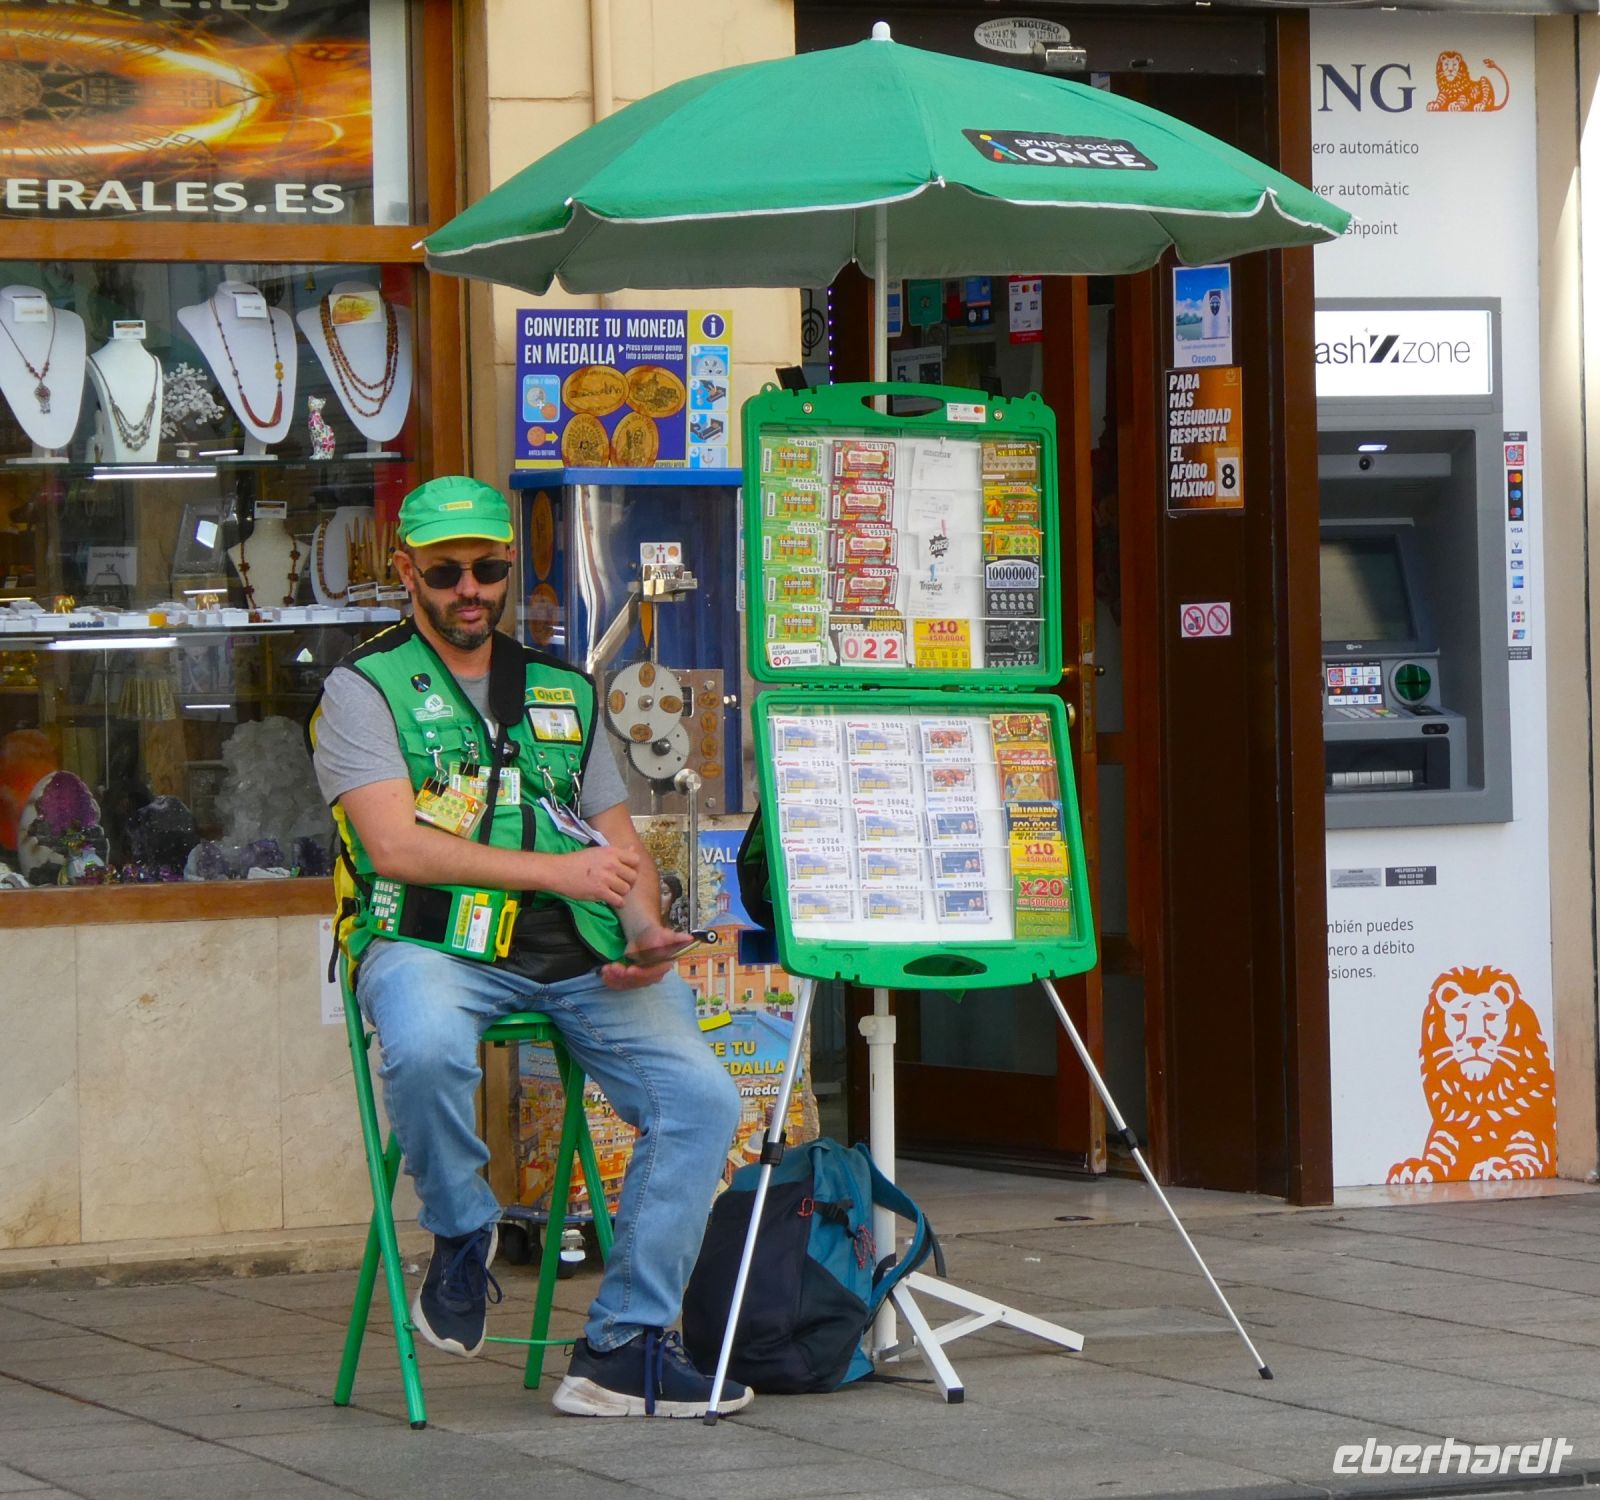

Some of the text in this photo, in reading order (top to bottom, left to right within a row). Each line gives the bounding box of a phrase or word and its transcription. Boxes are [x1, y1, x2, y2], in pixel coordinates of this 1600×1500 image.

[1012, 19, 1060, 34] TRIGUERO
[984, 38, 1017, 49] VALENCIA
[1317, 63, 1416, 113] NG
[1014, 137, 1129, 153] grupo social
[1339, 140, 1419, 154] automático
[1025, 148, 1147, 168] ONCE
[6, 179, 345, 214] ERALES.ES
[1338, 181, 1410, 196] automàtic
[1344, 221, 1398, 237] shpoint
[524, 317, 685, 339] CONVIERTE TU MONEDA
[524, 344, 616, 365] EN MEDALLA
[1191, 354, 1217, 364] Ozono
[1402, 341, 1471, 364] zone
[1169, 374, 1200, 391] PARA
[1169, 388, 1194, 409] MÁS
[1170, 408, 1232, 427] SEGURIDAD
[1170, 446, 1184, 462] EL
[1221, 463, 1236, 489] 8
[1170, 479, 1216, 498] MÁXIMO
[537, 690, 571, 701] ONCE
[702, 847, 740, 864] VAL
[1366, 917, 1414, 936] puedes
[1361, 944, 1370, 955] a
[1373, 941, 1415, 954] débito
[731, 1041, 756, 1056] TU
[740, 1083, 780, 1097] meda
